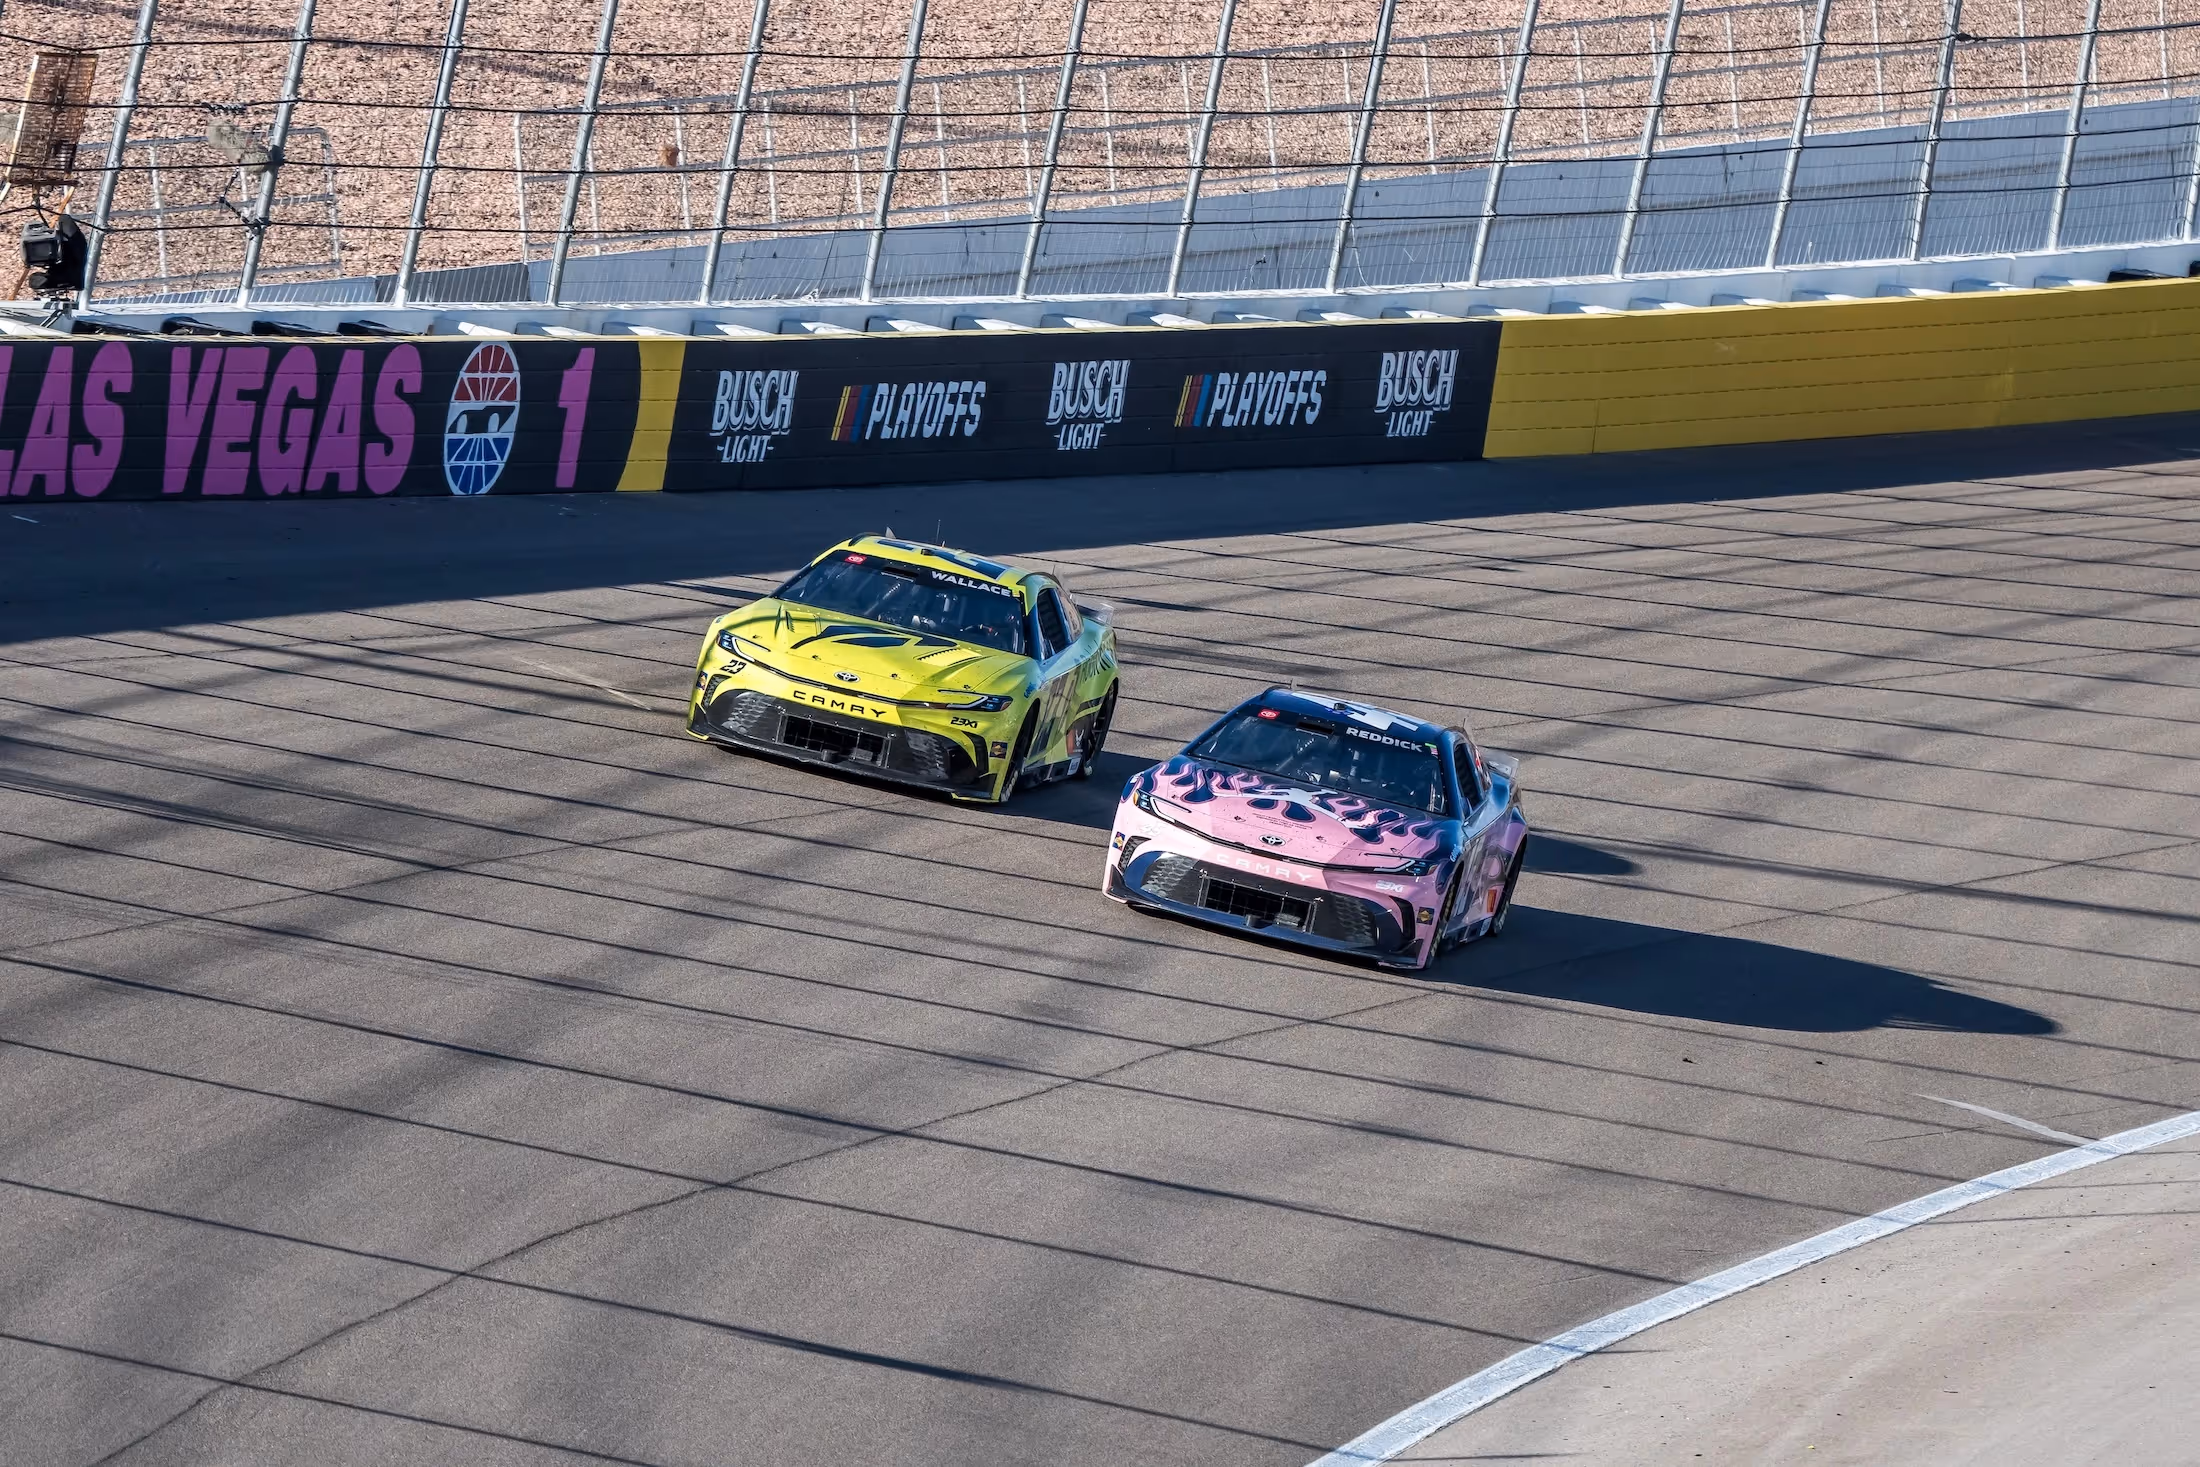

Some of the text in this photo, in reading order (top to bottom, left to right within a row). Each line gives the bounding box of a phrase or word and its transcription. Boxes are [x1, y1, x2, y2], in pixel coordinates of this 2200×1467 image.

[1046, 360, 1130, 425] BUSCH
[1374, 349, 1459, 413] BUSCH
[710, 370, 799, 436] BUSCH
[865, 381, 987, 440] PLAYOFFS
[1207, 370, 1327, 427] PLAYOFFS
[162, 343, 422, 496] VEGAS
[556, 347, 596, 488] 1
[1386, 410, 1434, 437] LIGHT
[719, 434, 773, 463] LIGHT
[1057, 423, 1105, 450] LIGHT
[931, 570, 1012, 598] WALLACE
[720, 659, 747, 674] 23
[793, 690, 887, 718] CAMRY
[1346, 727, 1423, 753] REDDICK
[1217, 854, 1313, 881] CAMRY
